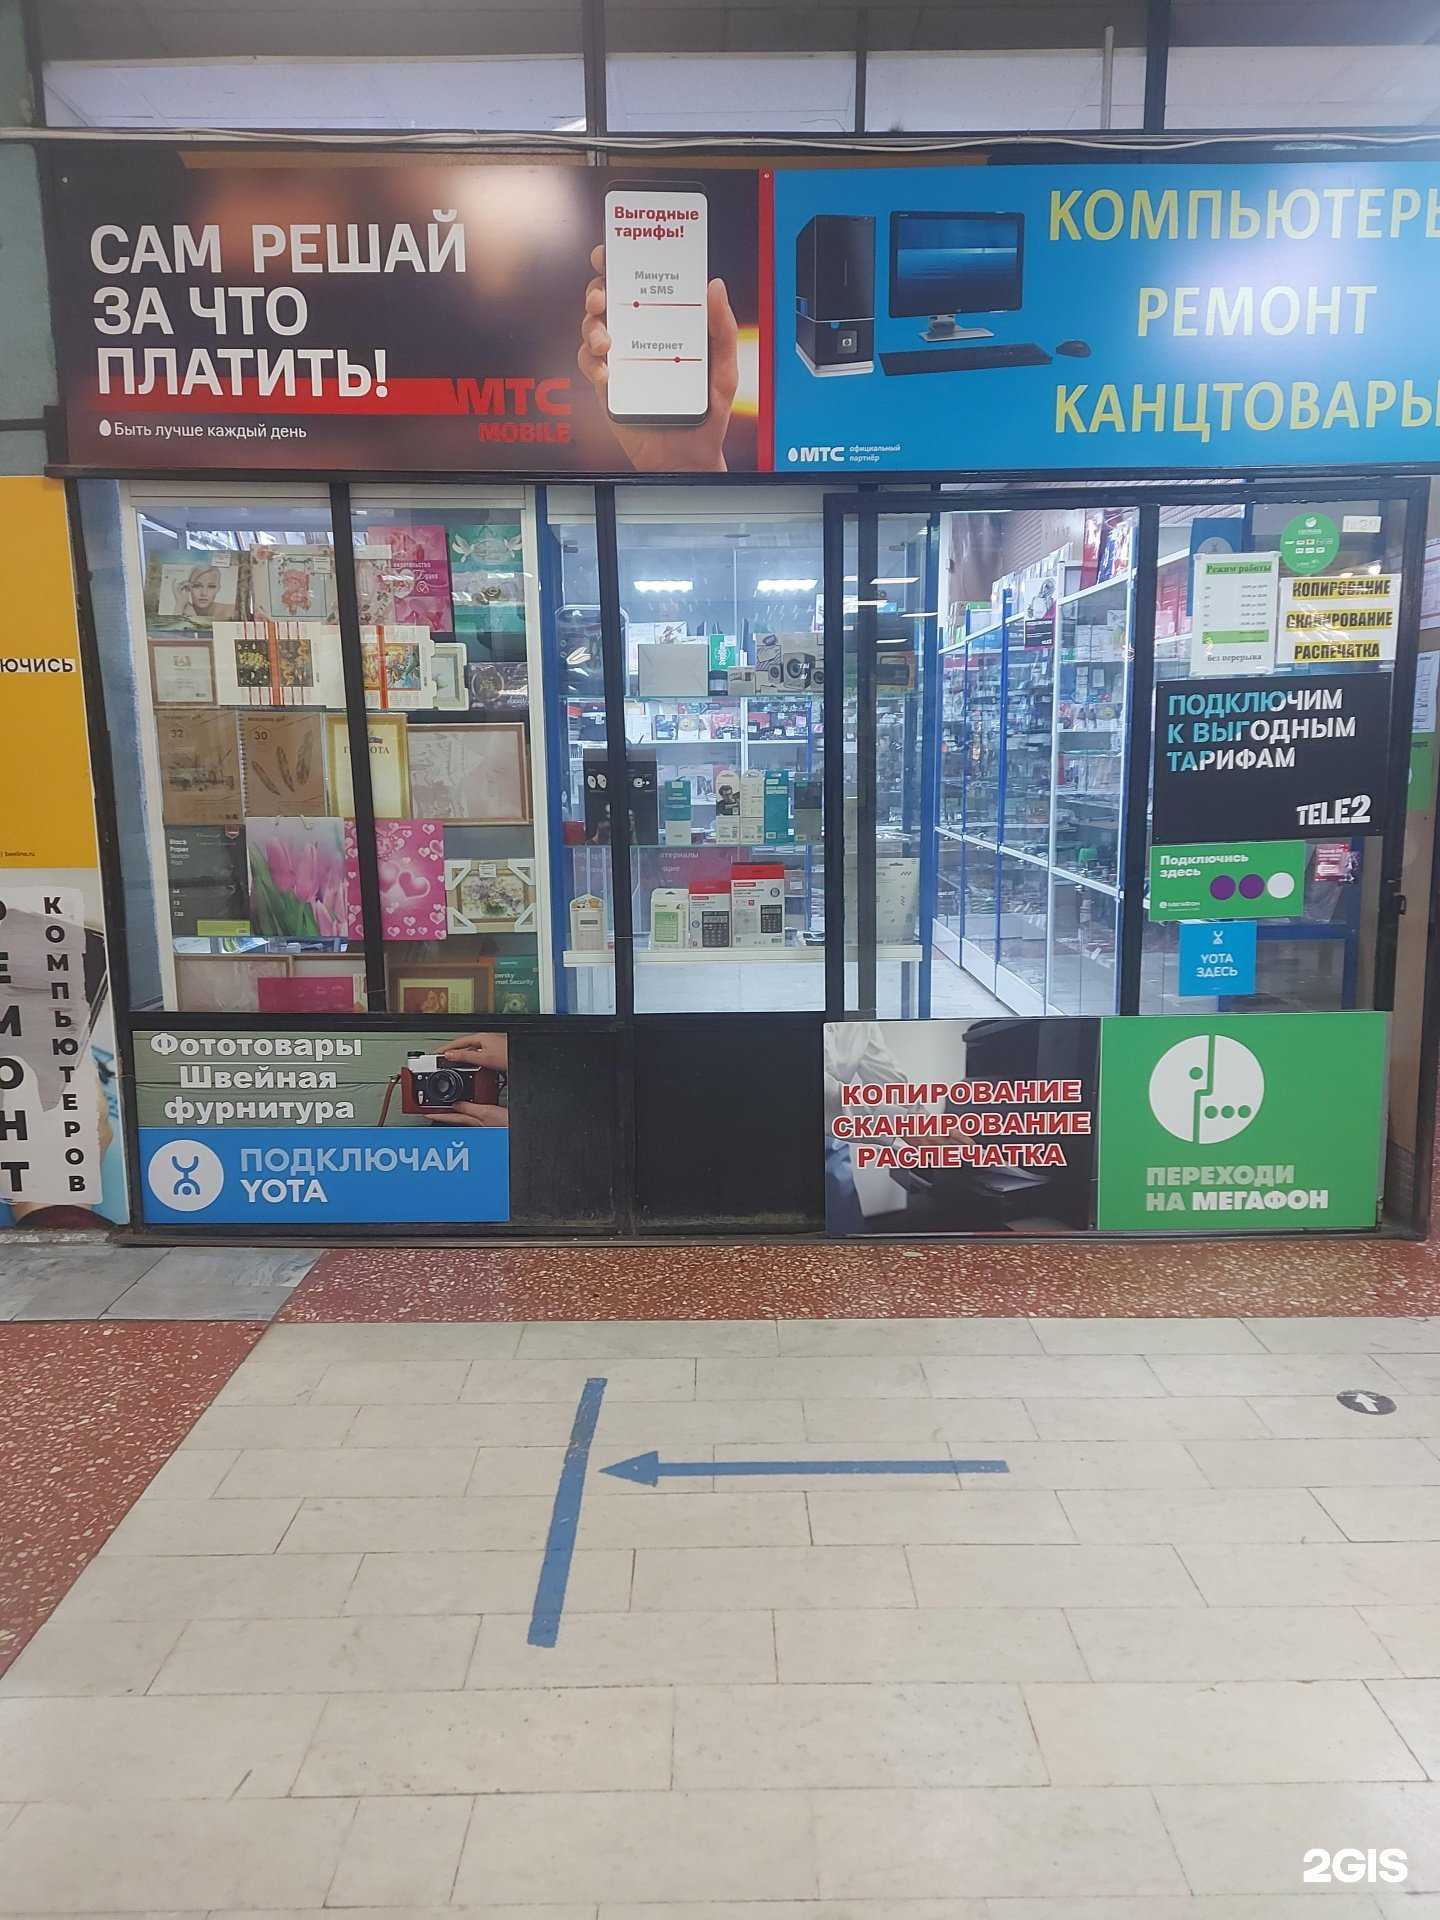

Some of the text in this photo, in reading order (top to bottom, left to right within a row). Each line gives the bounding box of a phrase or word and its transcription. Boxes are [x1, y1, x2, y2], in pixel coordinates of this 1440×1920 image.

[614, 206, 699, 221] Выгодные
[90, 208, 467, 274] САМ РЕШАЙ
[614, 226, 685, 240] тарифы!
[634, 270, 680, 282] Минуты
[640, 285, 675, 295] и SMS
[94, 286, 308, 337] ЗА ЧТО
[1137, 285, 1378, 337] РЕМОНТ
[631, 340, 684, 351] Интернет
[98, 347, 388, 398] ПЛАТИТЬ!
[456, 378, 571, 415] МТС
[1055, 379, 1440, 442] КАНЦТОВАРЫ
[114, 421, 307, 441] Быть лучше каждый день
[478, 423, 571, 443] MOBILE
[800, 446, 845, 462] МТС
[849, 444, 901, 453] официальный
[1206, 563, 1272, 574] Режим работы
[1292, 579, 1391, 597] КОПИРОВАНИЕ
[1286, 611, 1393, 630] СКАНИРОВАНИЕ
[1294, 643, 1380, 660] РАСПЕЧАТКА
[1168, 689, 1343, 718] ПОДКЛЮЧИМ
[1168, 716, 1356, 744] К ВЫГОДНЫМ
[1167, 747, 1296, 772] ТАРИФАМ
[1296, 795, 1372, 826] TELE2
[1160, 854, 1249, 866] Подключись
[1160, 868, 1201, 878] здесь
[1200, 953, 1234, 964] YOTA
[1196, 967, 1238, 978] ЗДЕСЬ
[43, 896, 86, 1193] КОМПЬЮТЕРОВ
[150, 1032, 362, 1061] Фототовары
[179, 1066, 337, 1089] Швейная
[841, 1080, 1082, 1106] КОПИРОВАНИЕ
[164, 1096, 354, 1124] фурнитура
[833, 1112, 1091, 1138] СКАНИРОВАНИЕ
[240, 1141, 469, 1176] ПОДКЛЮЧАЙ
[857, 1144, 1067, 1169] РАСПЕЧАТКА
[1146, 1165, 1295, 1188] ПЕРЕХОДИ
[240, 1179, 328, 1203] YOTA
[1146, 1190, 1329, 1211] НА МЕГАФОН
